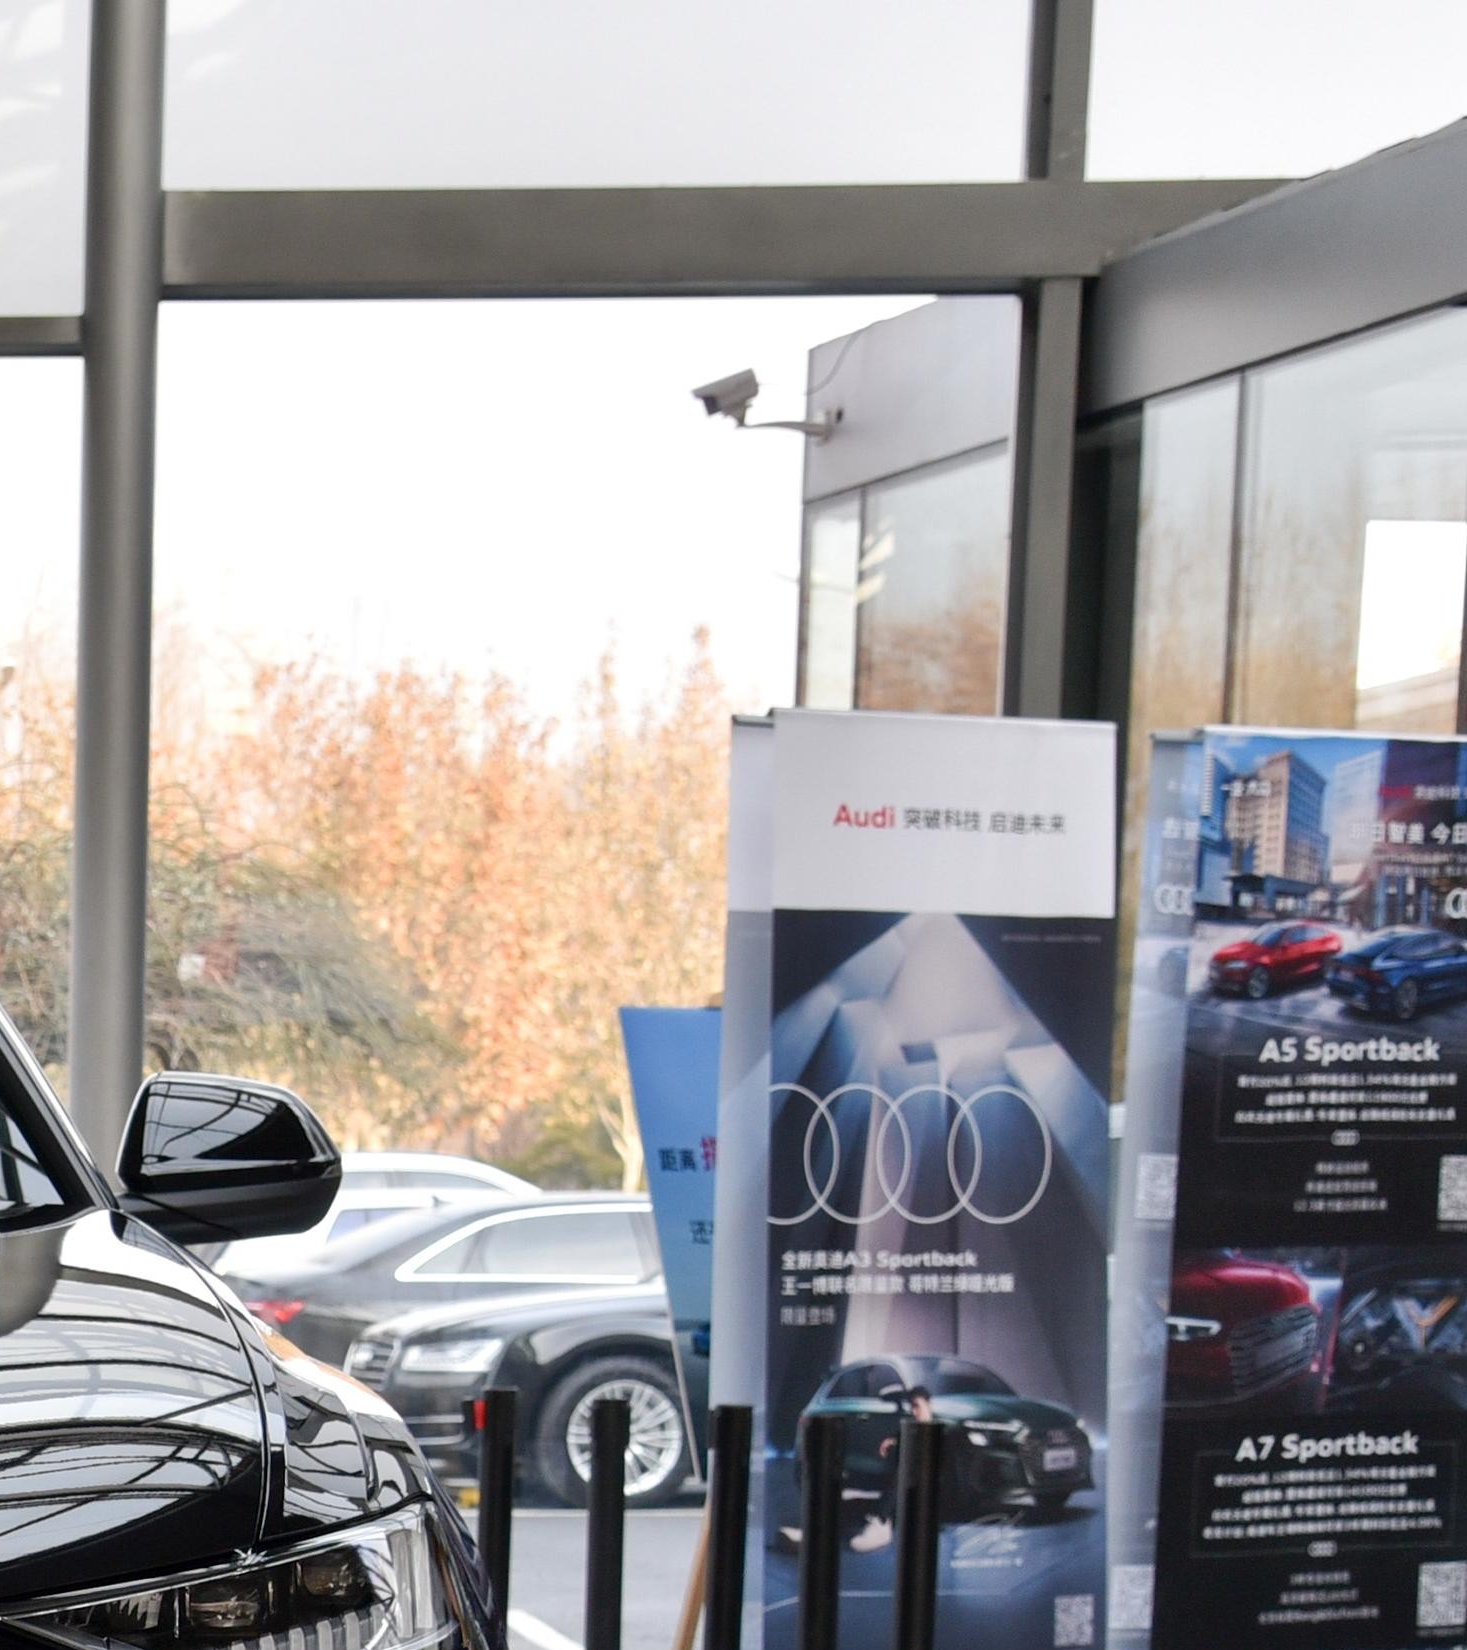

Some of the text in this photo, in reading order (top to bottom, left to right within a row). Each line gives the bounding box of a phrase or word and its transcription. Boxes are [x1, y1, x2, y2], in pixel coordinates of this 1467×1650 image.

[833, 804, 1065, 834] Audi 突破科技 启迪未来
[1259, 1034, 1441, 1067] A5 Sportback
[876, 1250, 978, 1271] Sportback
[1235, 1430, 1419, 1463] A7 Sportback
